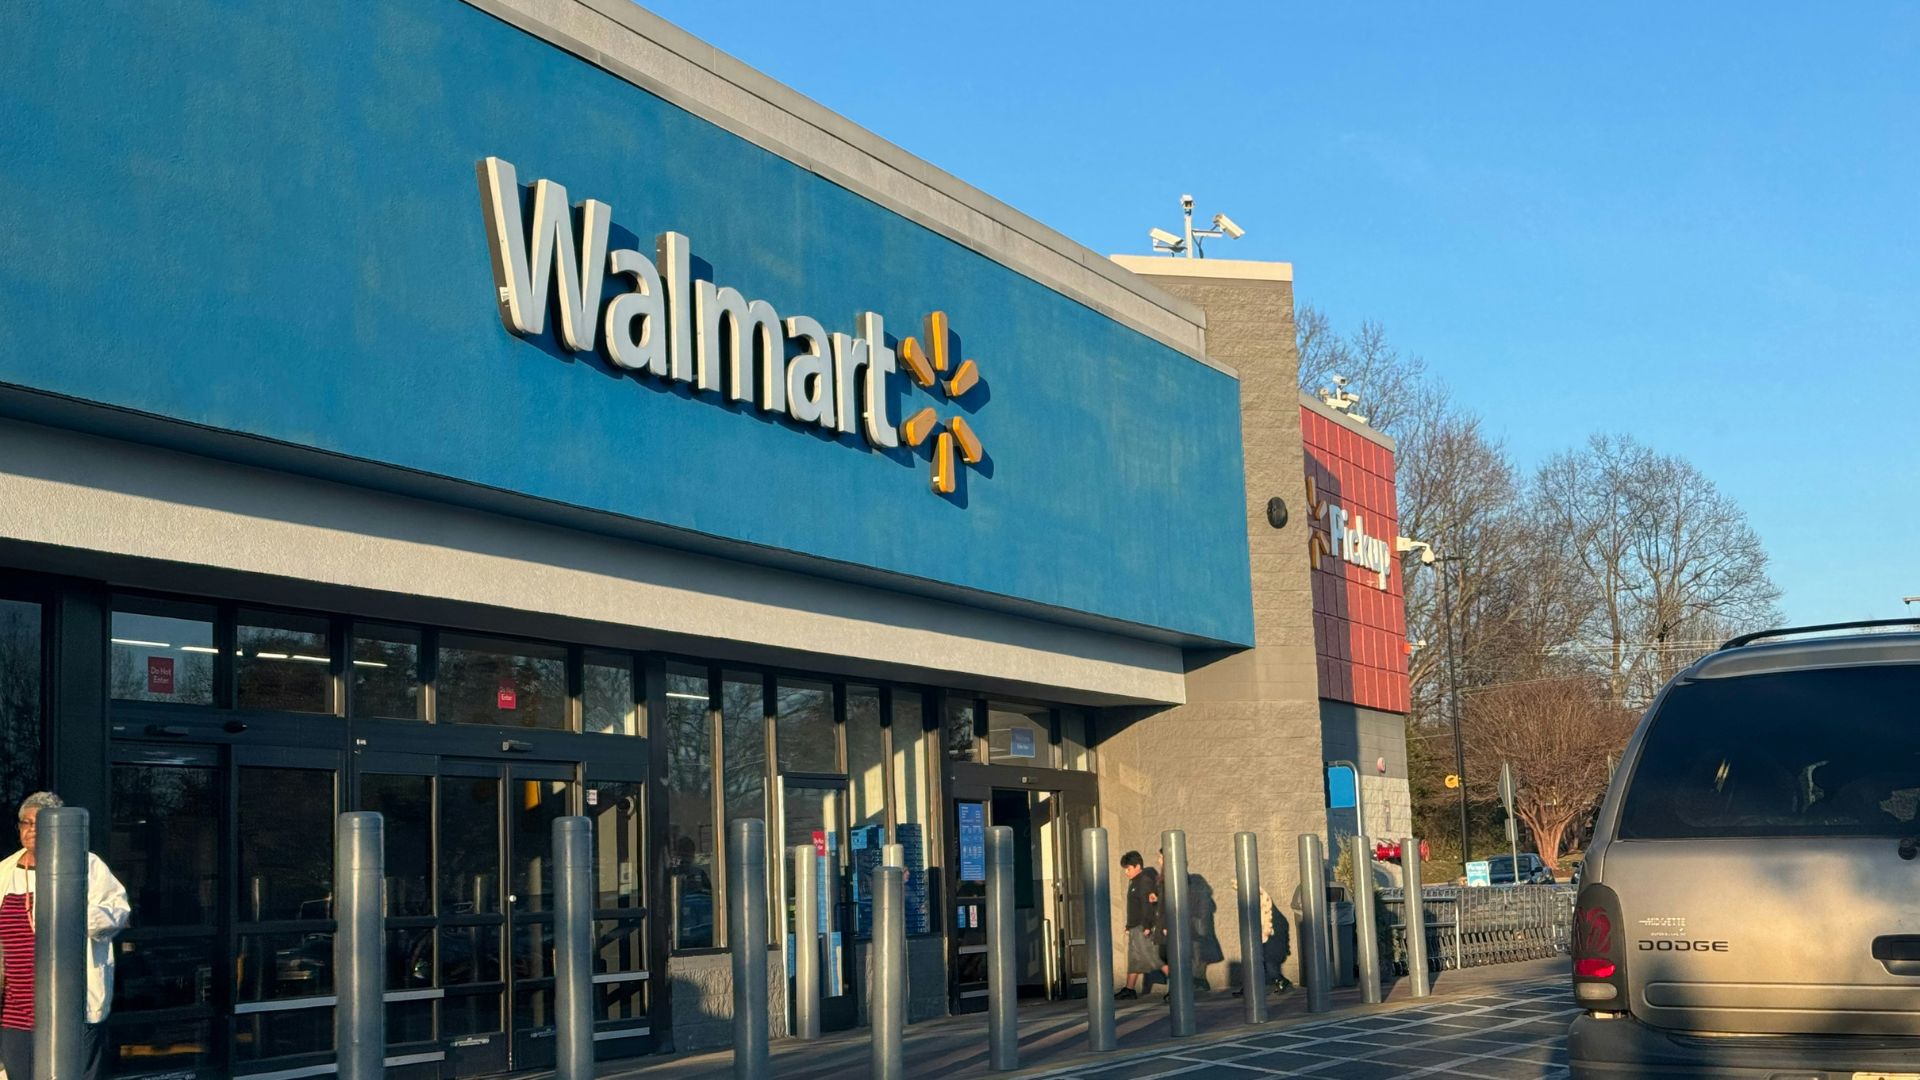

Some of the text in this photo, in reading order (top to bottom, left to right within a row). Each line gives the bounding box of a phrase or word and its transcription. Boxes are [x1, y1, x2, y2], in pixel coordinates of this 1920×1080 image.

[477, 156, 898, 449] Walmart
[1329, 504, 1391, 590] Pickup
[150, 666, 172, 676] Do Not
[153, 675, 169, 684] Enter
[1638, 940, 1728, 952] DODGE
